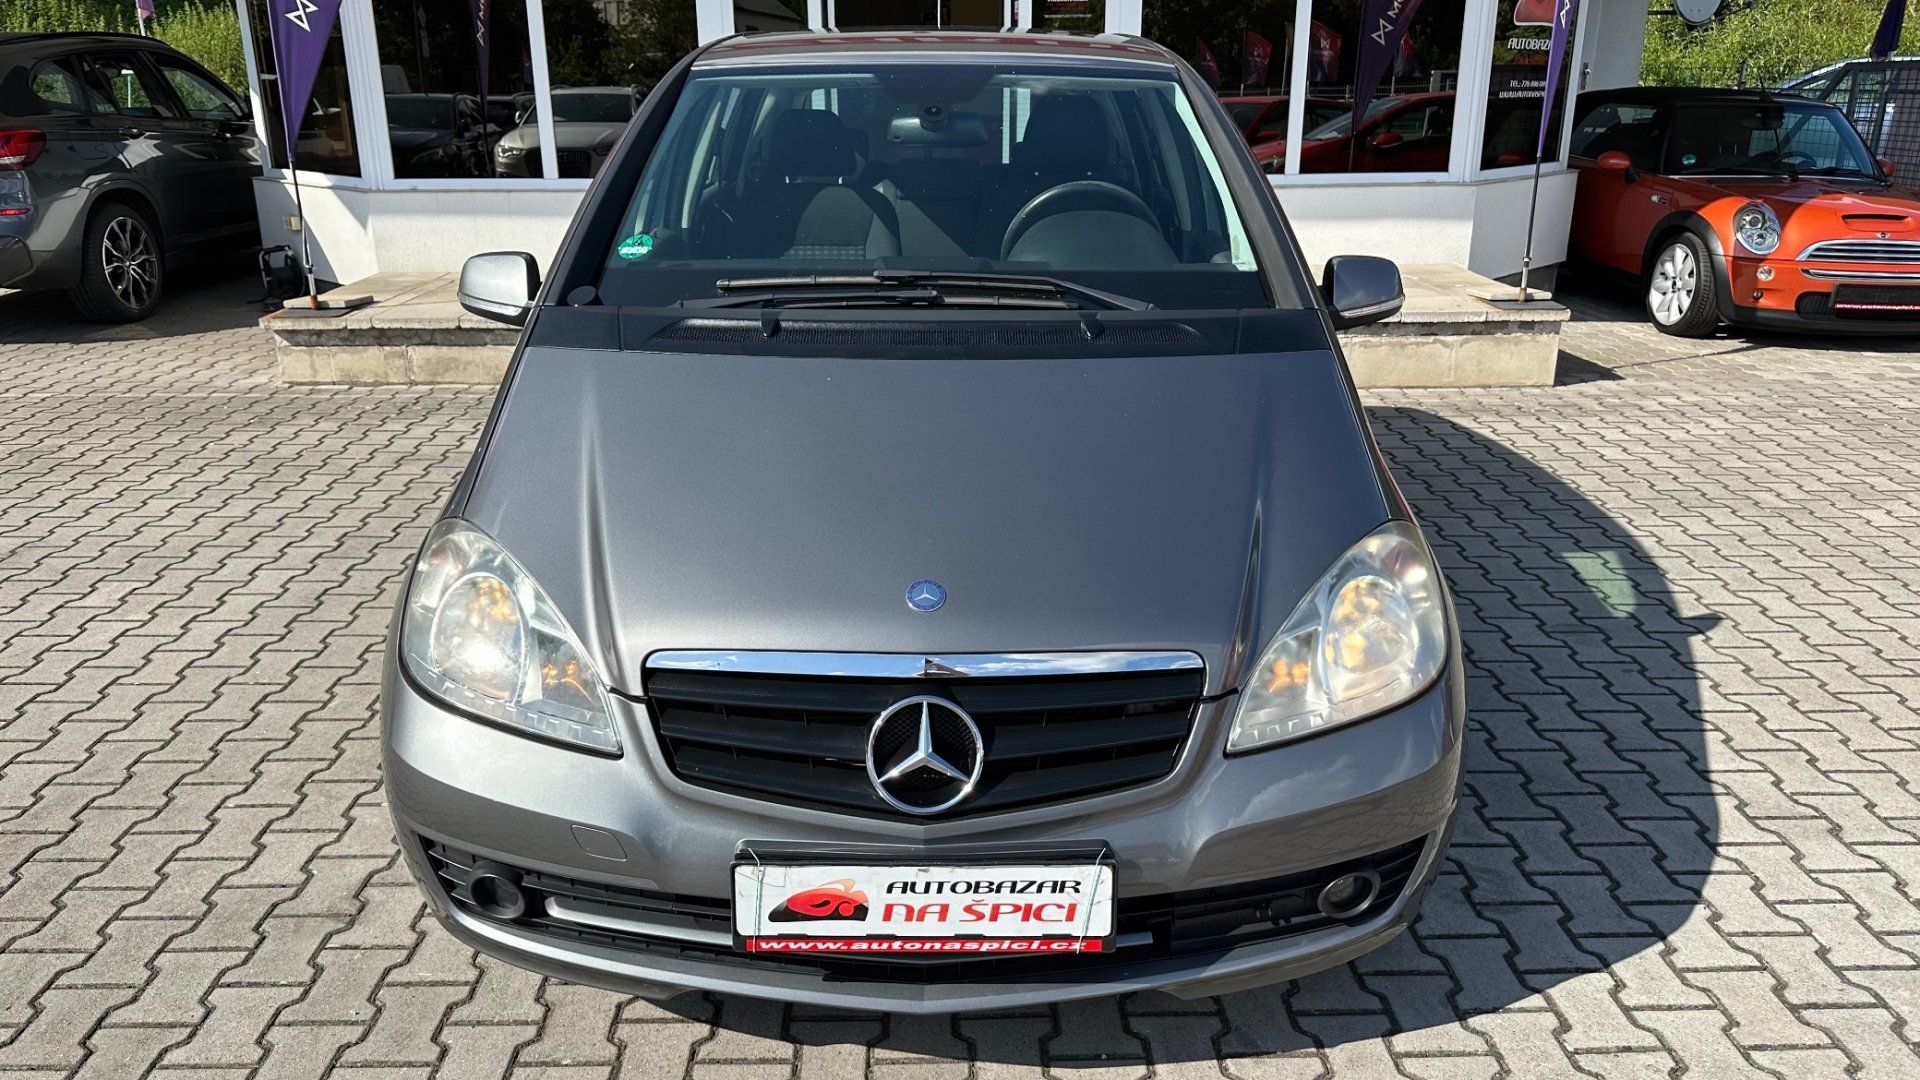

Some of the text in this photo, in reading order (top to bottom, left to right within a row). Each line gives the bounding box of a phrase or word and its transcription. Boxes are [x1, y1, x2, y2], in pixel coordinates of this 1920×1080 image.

[885, 880, 1082, 895] AUTOBAZAR
[881, 898, 1078, 922] NA ŠPICI
[759, 940, 1087, 952] www.autonaspici.cz
